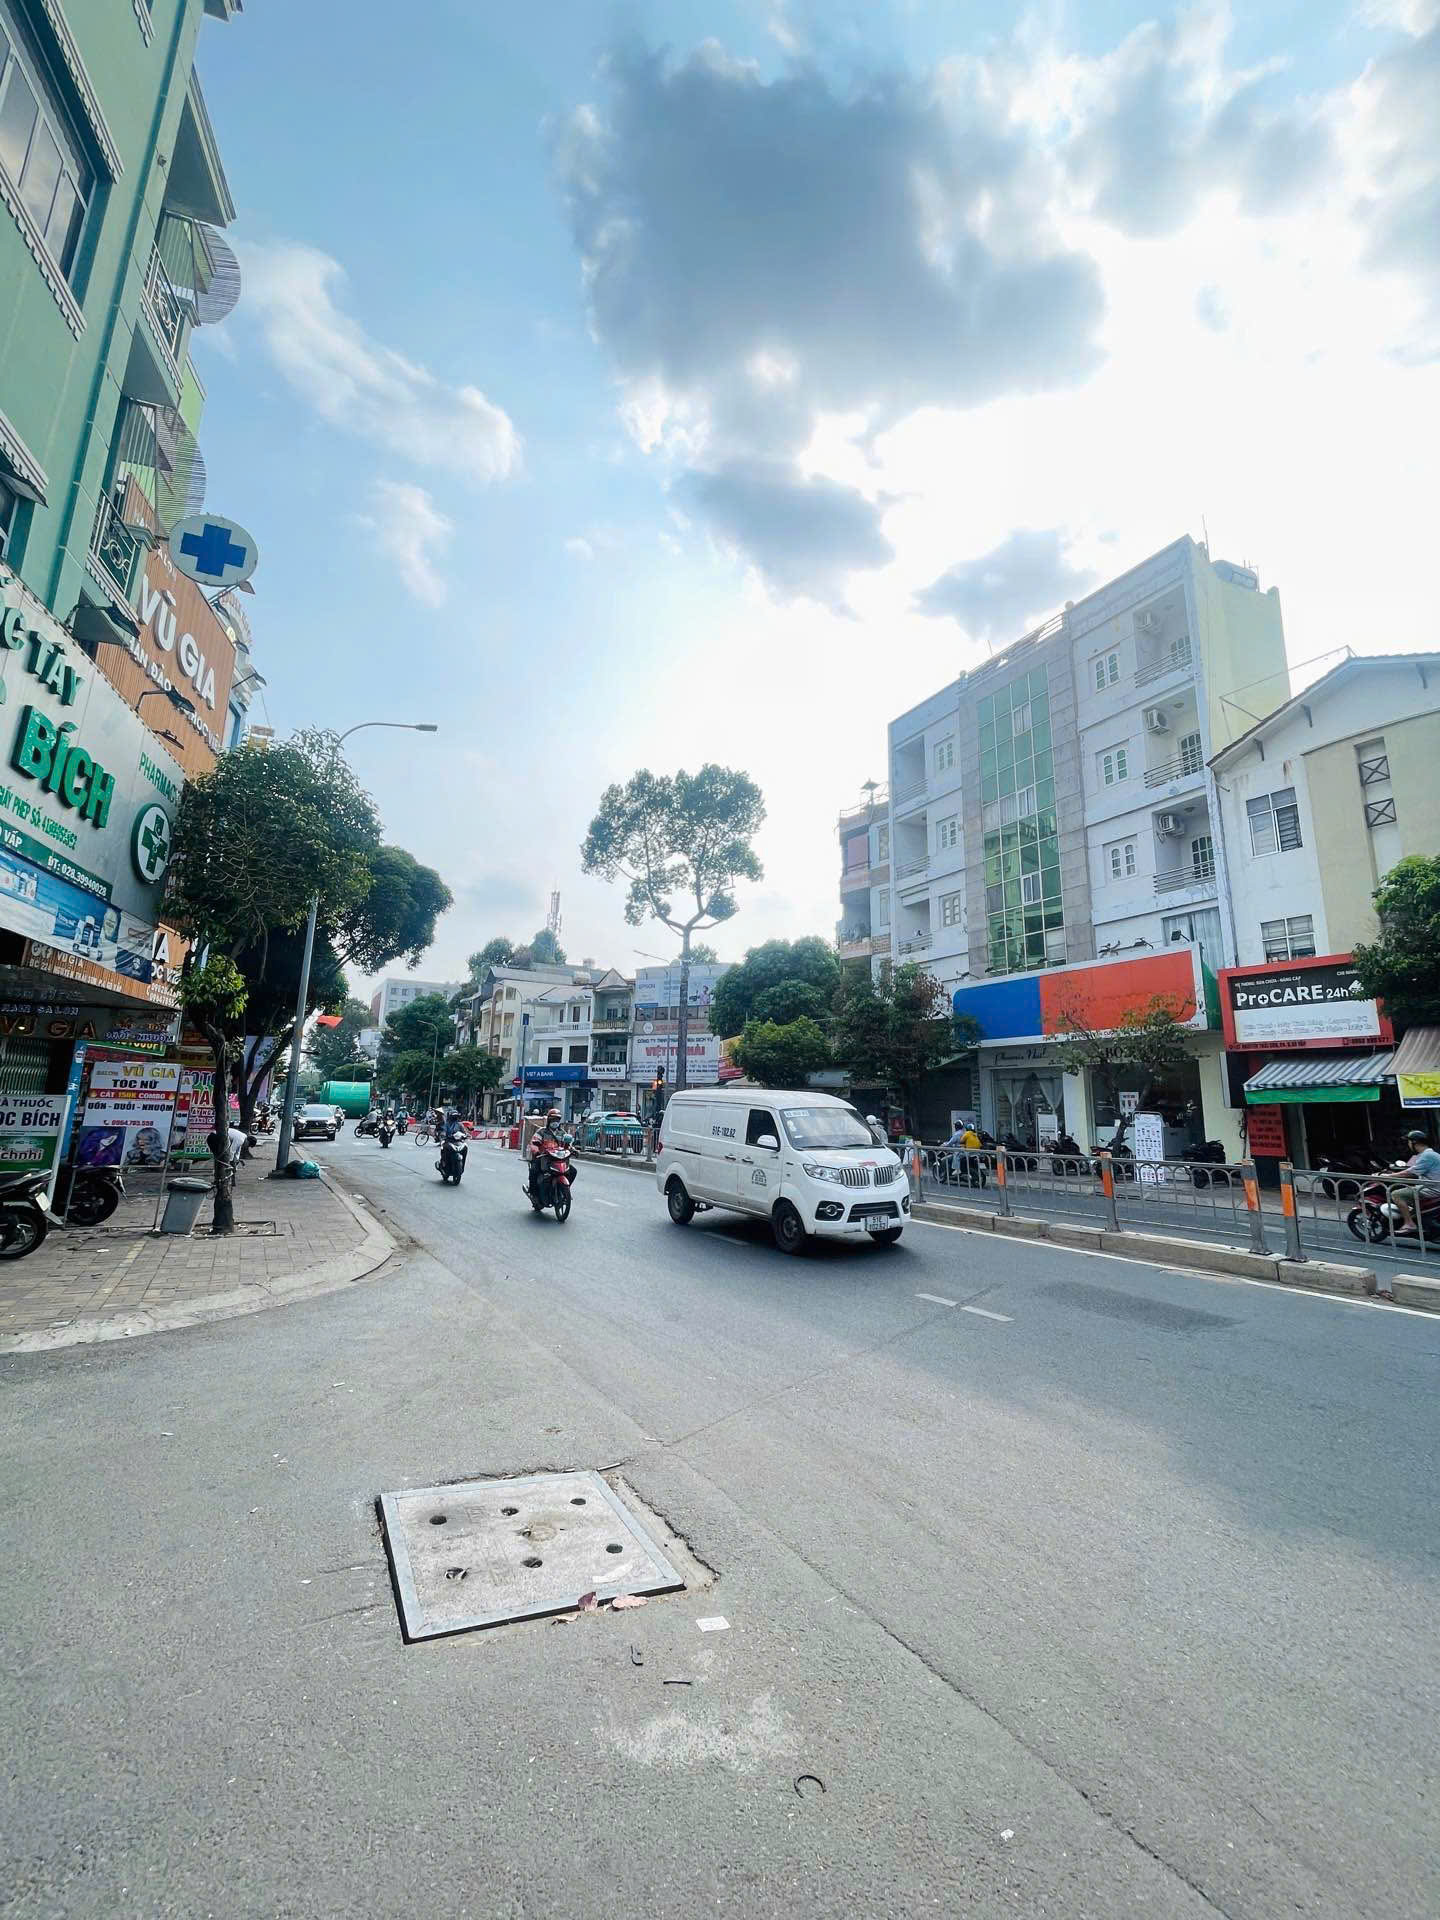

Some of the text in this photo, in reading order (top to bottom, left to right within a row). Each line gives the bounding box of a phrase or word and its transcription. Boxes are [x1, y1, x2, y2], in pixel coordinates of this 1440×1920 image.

[141, 574, 178, 651] VŨ
[178, 633, 216, 710] GIA
[29, 630, 85, 706] TÂY
[13, 705, 116, 828] BÍCH
[4, 830, 22, 848] VẤP
[1236, 984, 1349, 1007] ProCARE 24h
[151, 1067, 177, 1079] GIA
[13, 1096, 54, 1109] THUỐC
[141, 1103, 174, 1113] NHUỘM
[21, 1108, 61, 1127] BÍCH
